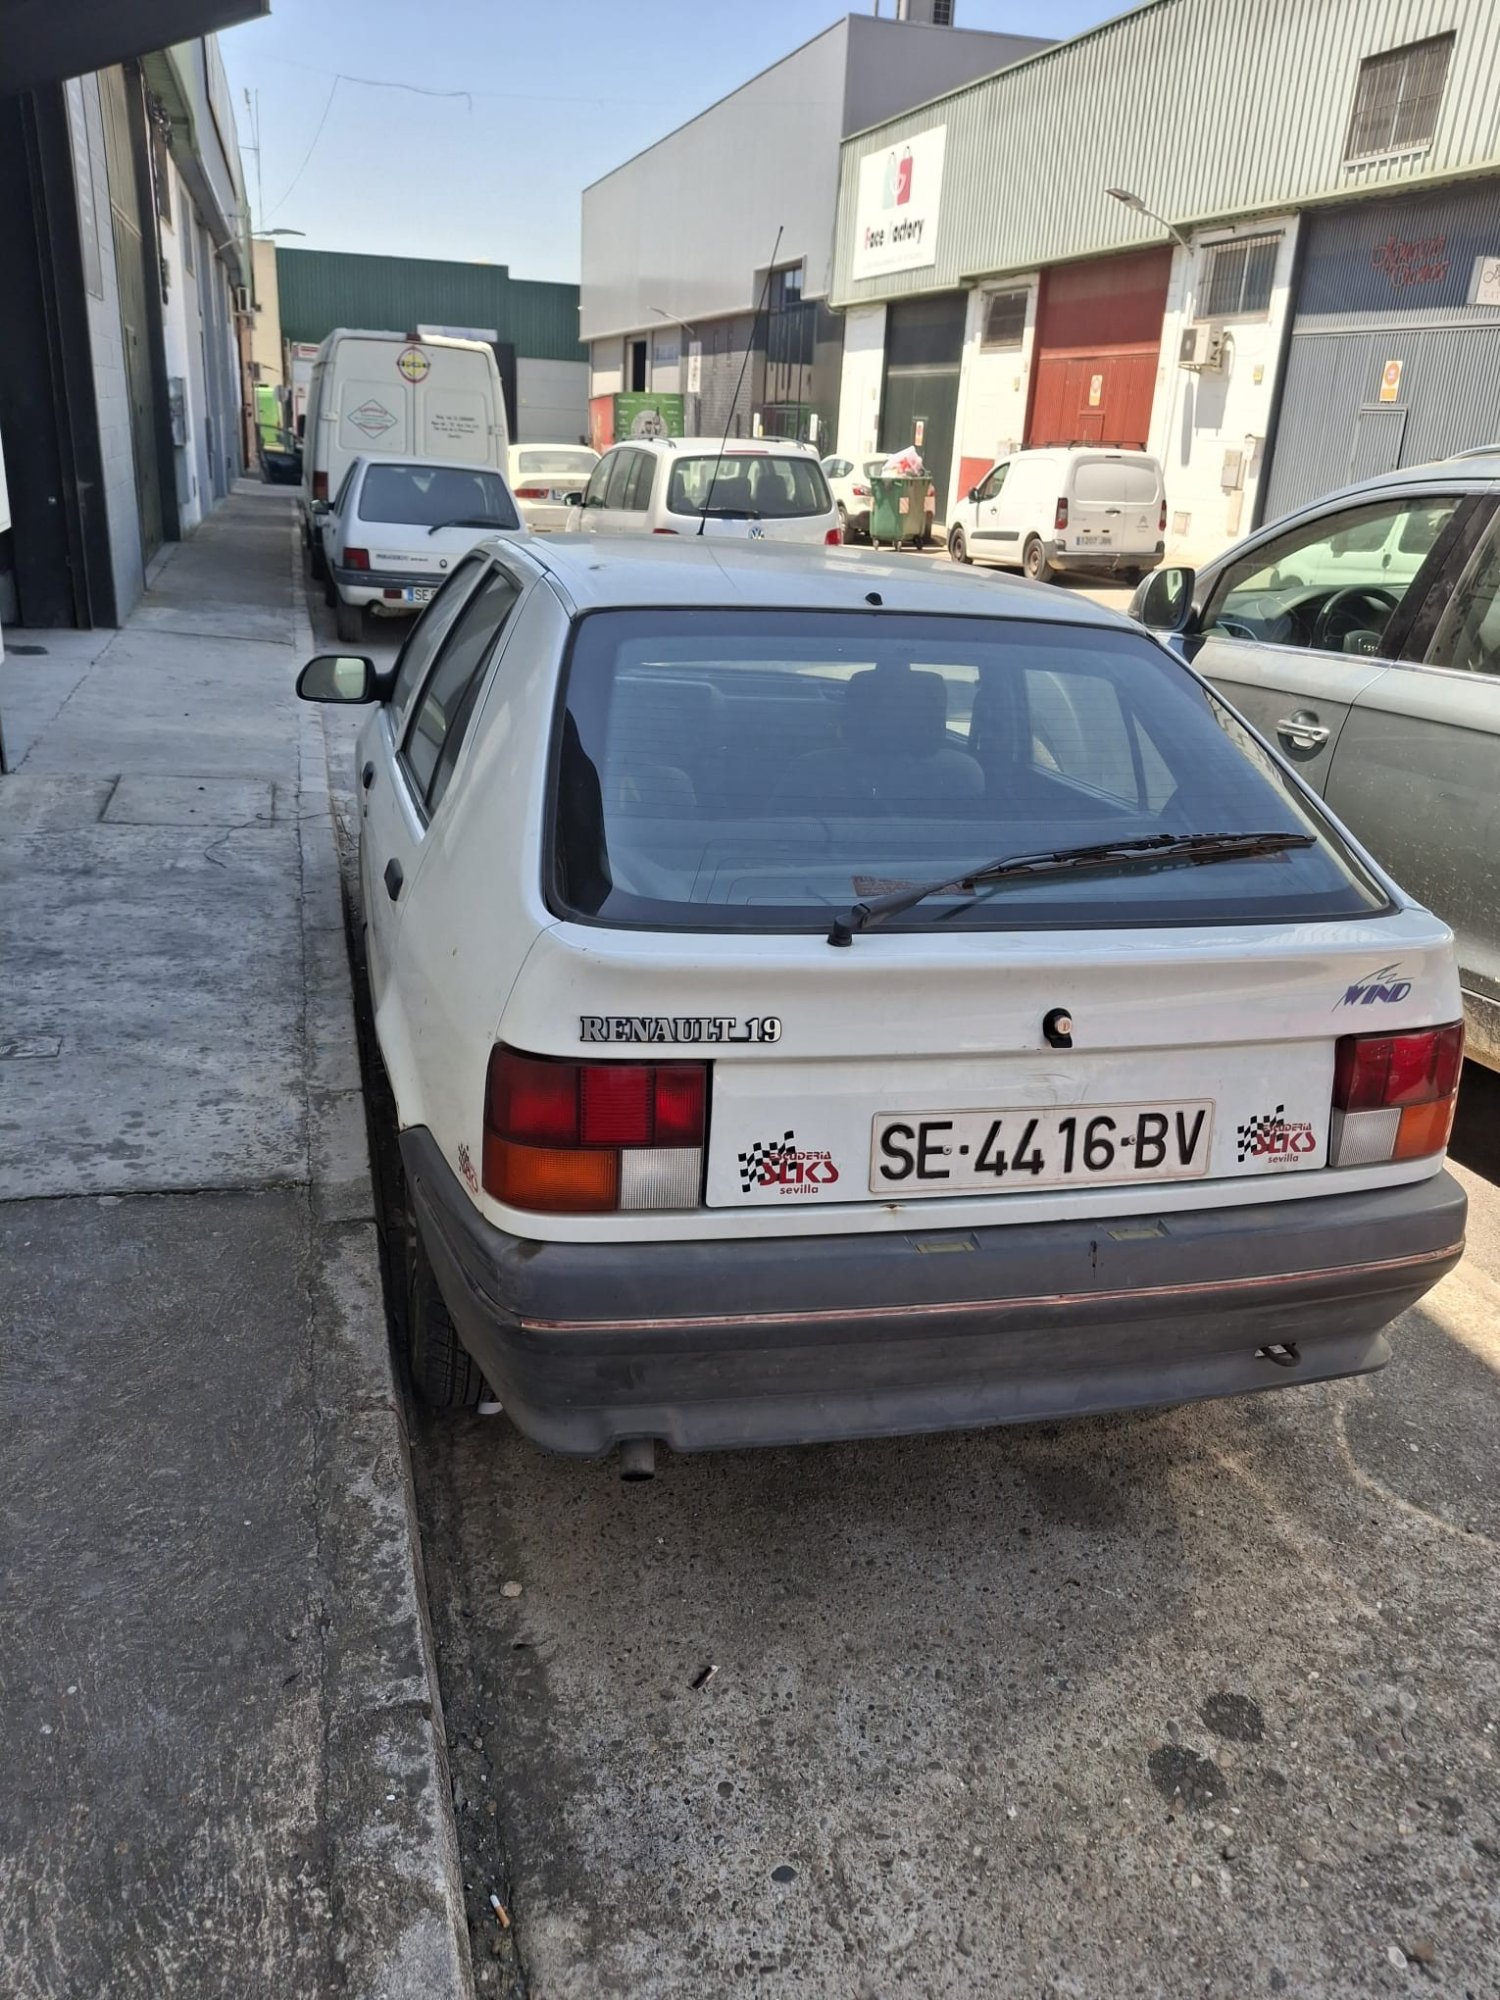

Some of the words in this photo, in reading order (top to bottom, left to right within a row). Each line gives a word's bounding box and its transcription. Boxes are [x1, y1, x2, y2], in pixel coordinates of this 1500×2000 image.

[1343, 982, 1411, 1006] WIND
[580, 1016, 737, 1042] RENAULT
[746, 1016, 783, 1042] 19
[1268, 1153, 1298, 1164] sevilla
[779, 1184, 819, 1195] sevilla
